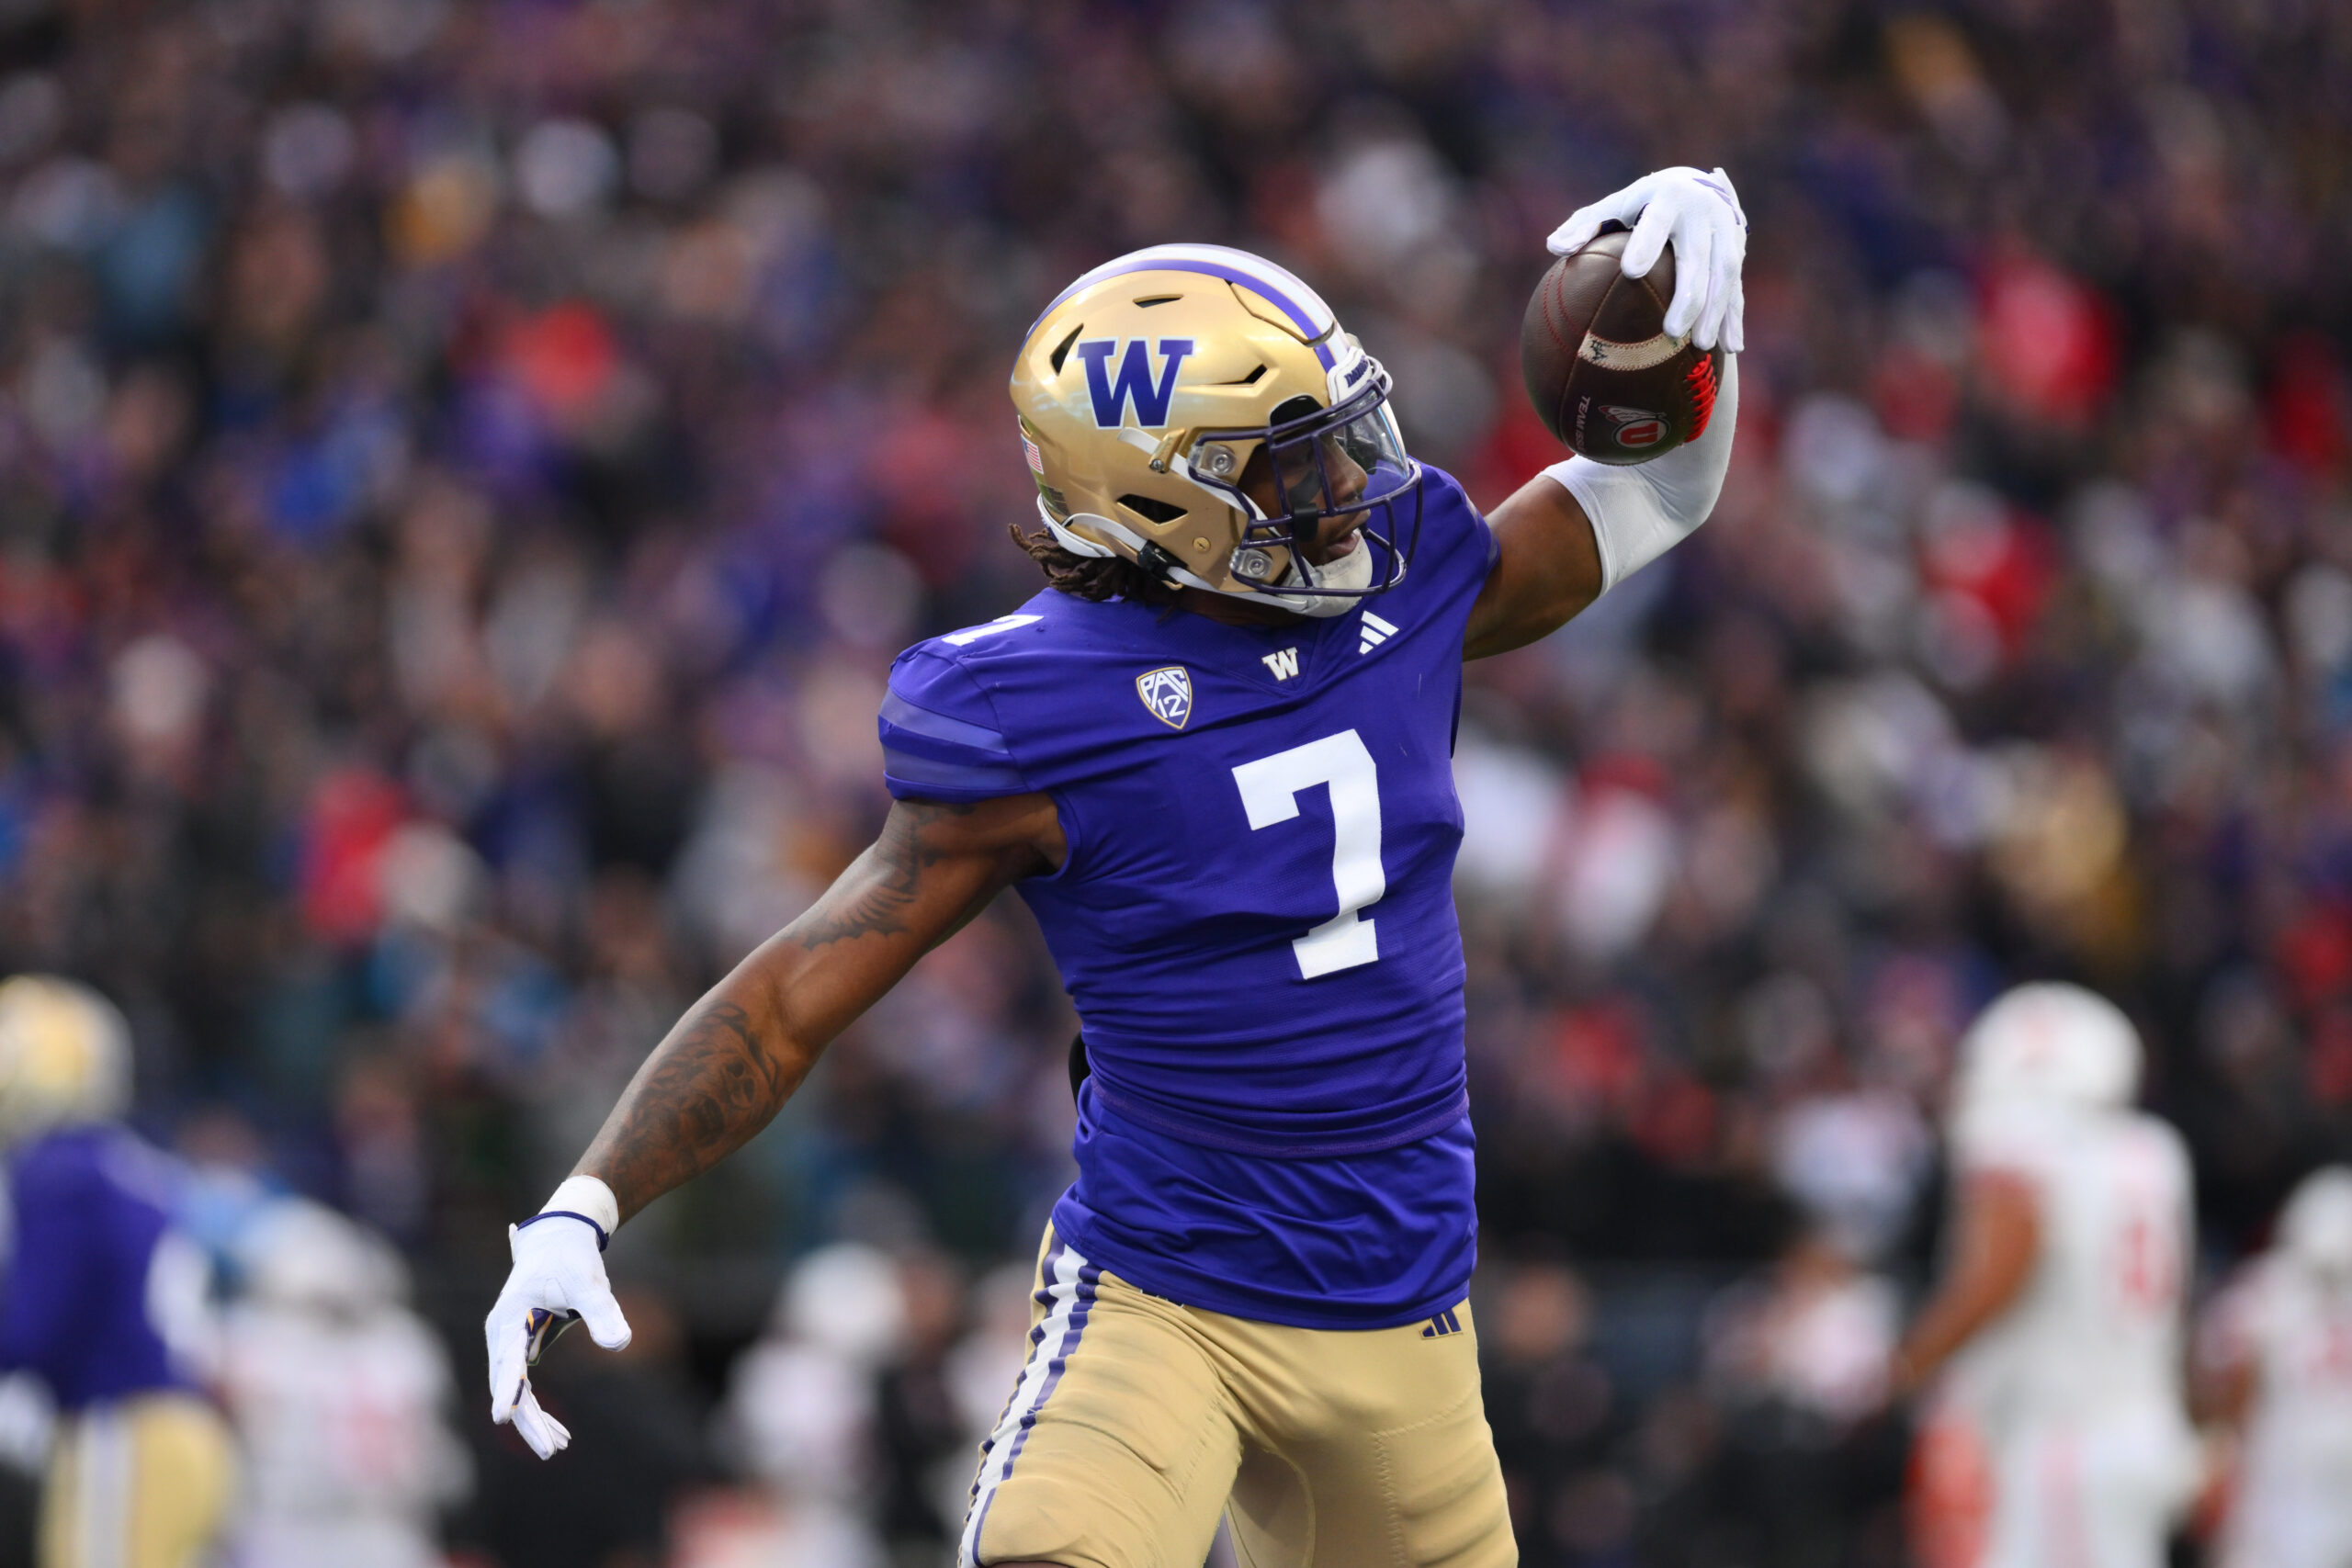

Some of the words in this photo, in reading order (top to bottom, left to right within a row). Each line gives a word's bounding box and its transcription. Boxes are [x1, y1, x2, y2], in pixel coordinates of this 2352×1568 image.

[1077, 338, 1194, 428] W
[1576, 396, 1591, 430] TEAM
[1620, 422, 1659, 446] U
[1261, 647, 1299, 681] W
[1140, 670, 1189, 710] PAC
[1157, 694, 1186, 718] 12
[1231, 728, 1385, 980] 7
